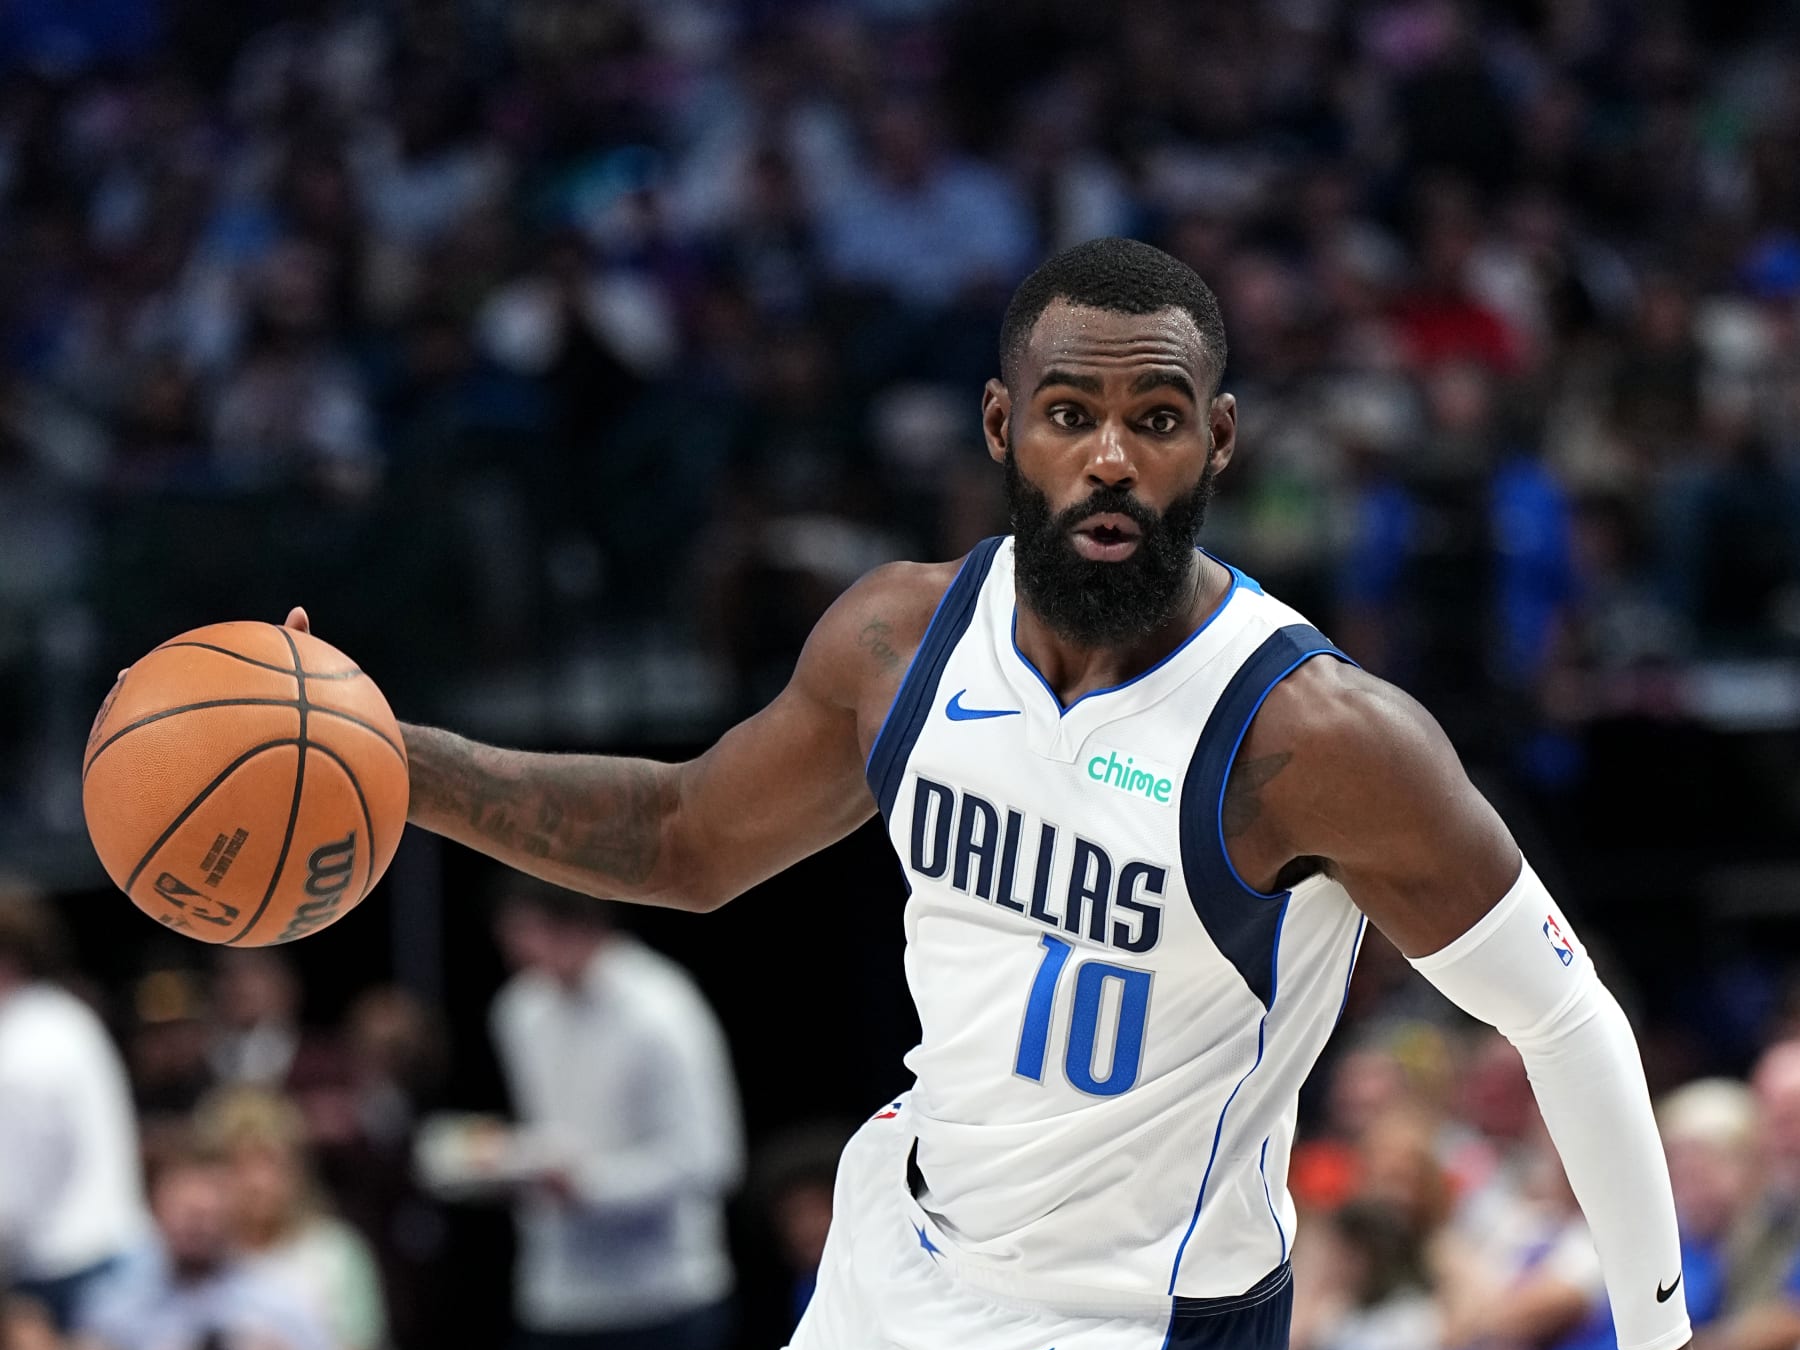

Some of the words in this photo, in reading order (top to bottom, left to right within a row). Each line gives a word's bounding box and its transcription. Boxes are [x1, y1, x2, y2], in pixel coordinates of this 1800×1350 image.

[1087, 751, 1172, 803] chime
[910, 772, 1171, 954] DALLAS
[1011, 932, 1156, 1097] 10
